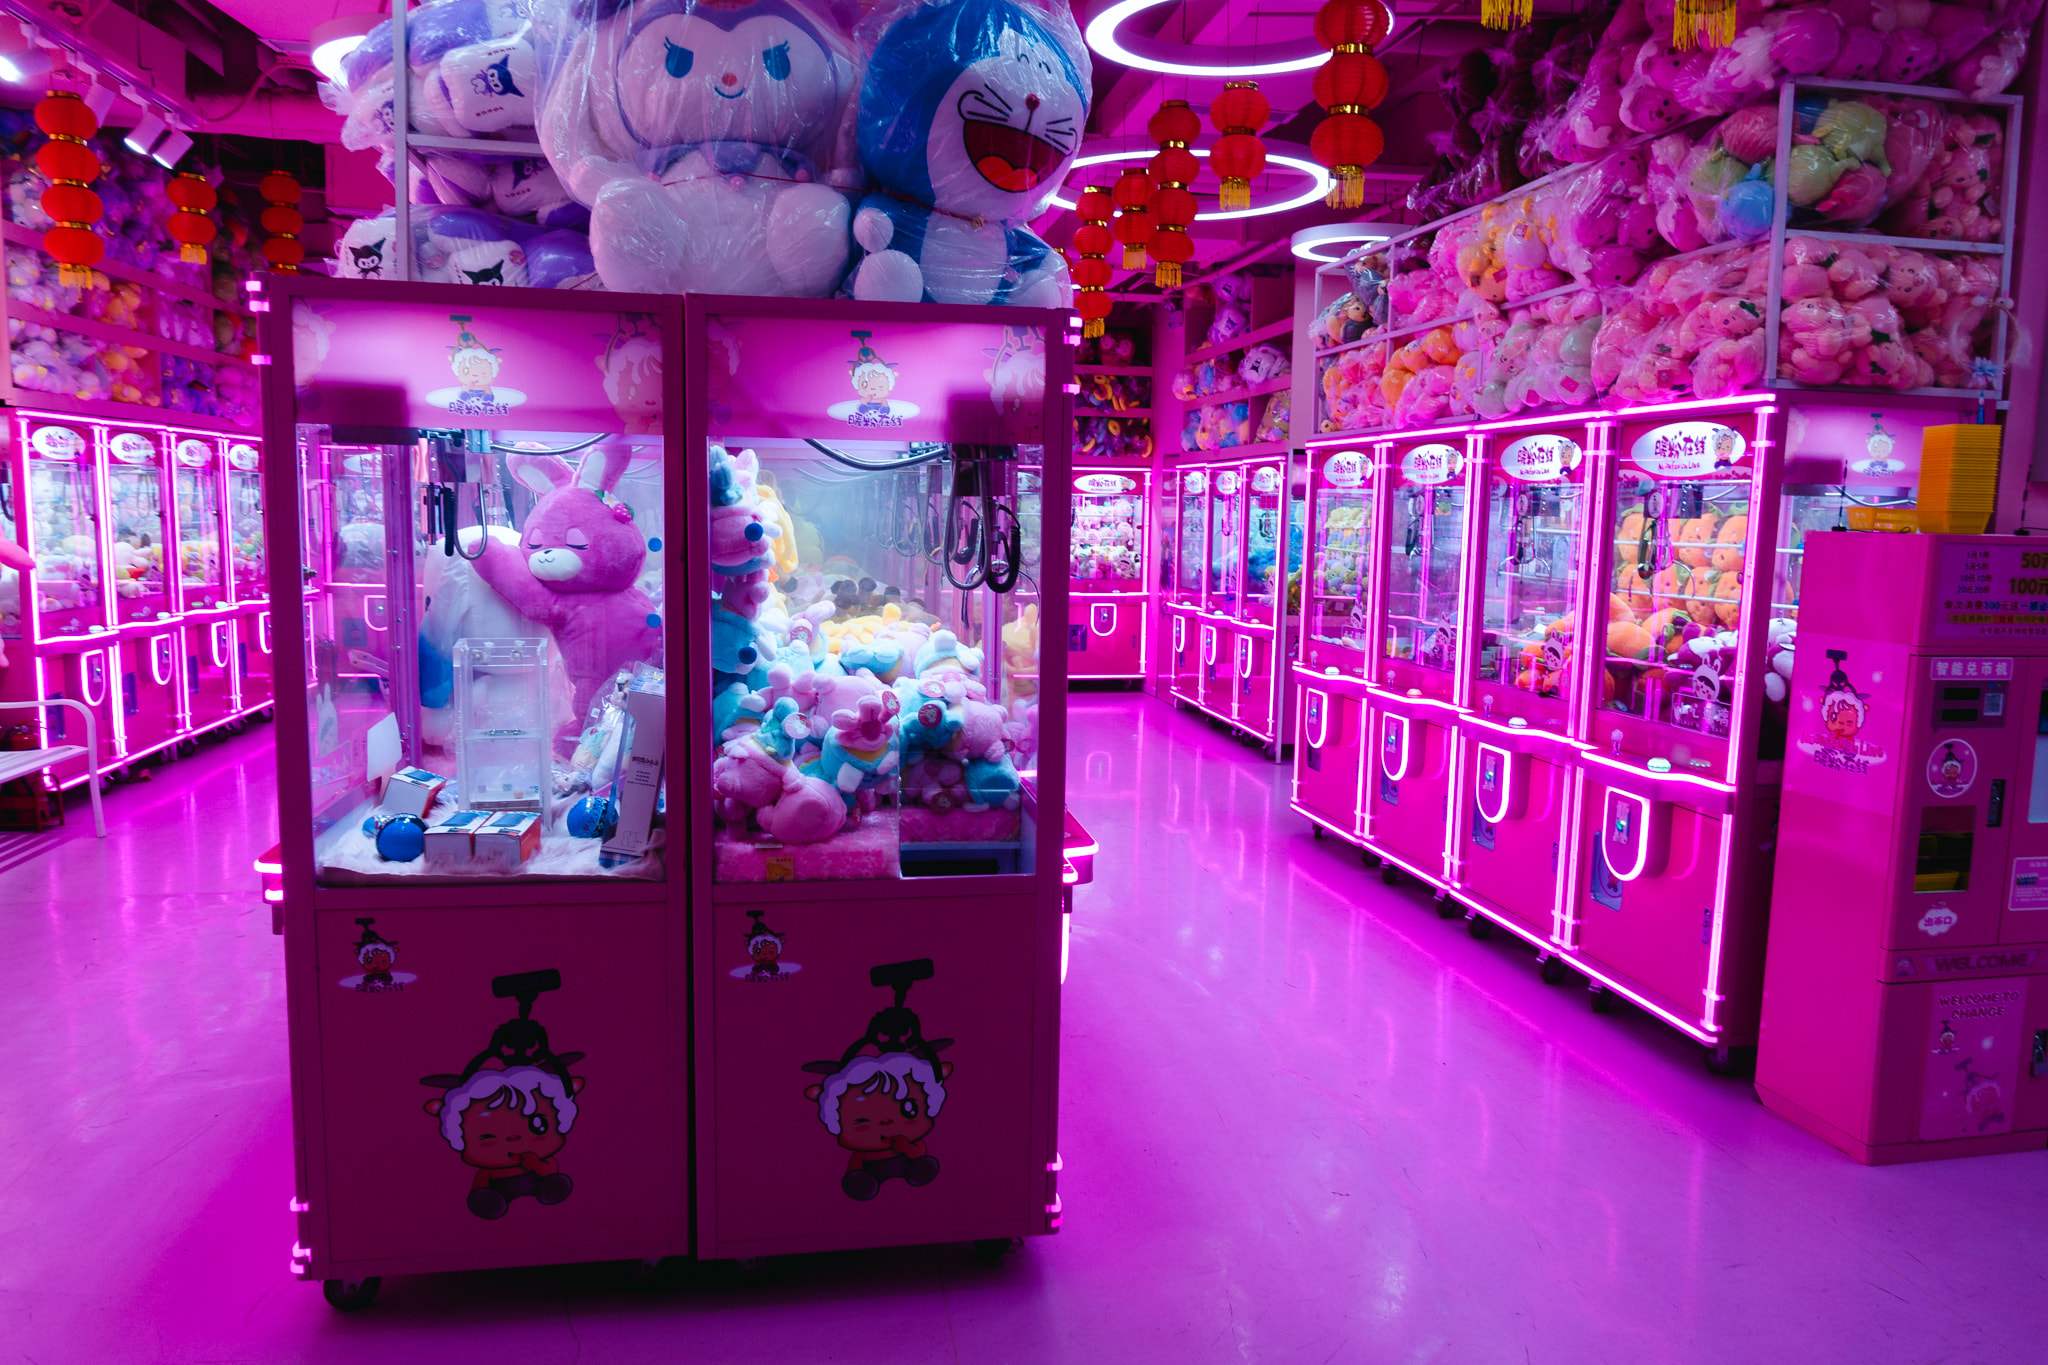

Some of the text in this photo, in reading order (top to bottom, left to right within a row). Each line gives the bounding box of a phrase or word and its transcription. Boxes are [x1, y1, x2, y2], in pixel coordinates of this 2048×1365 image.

[1936, 661, 2007, 676] 智能兑币机
[1934, 953, 2029, 972] WELCOME
[1939, 991, 2019, 1006] WELCOME TO
[1951, 1006, 2005, 1020] CHANGE
